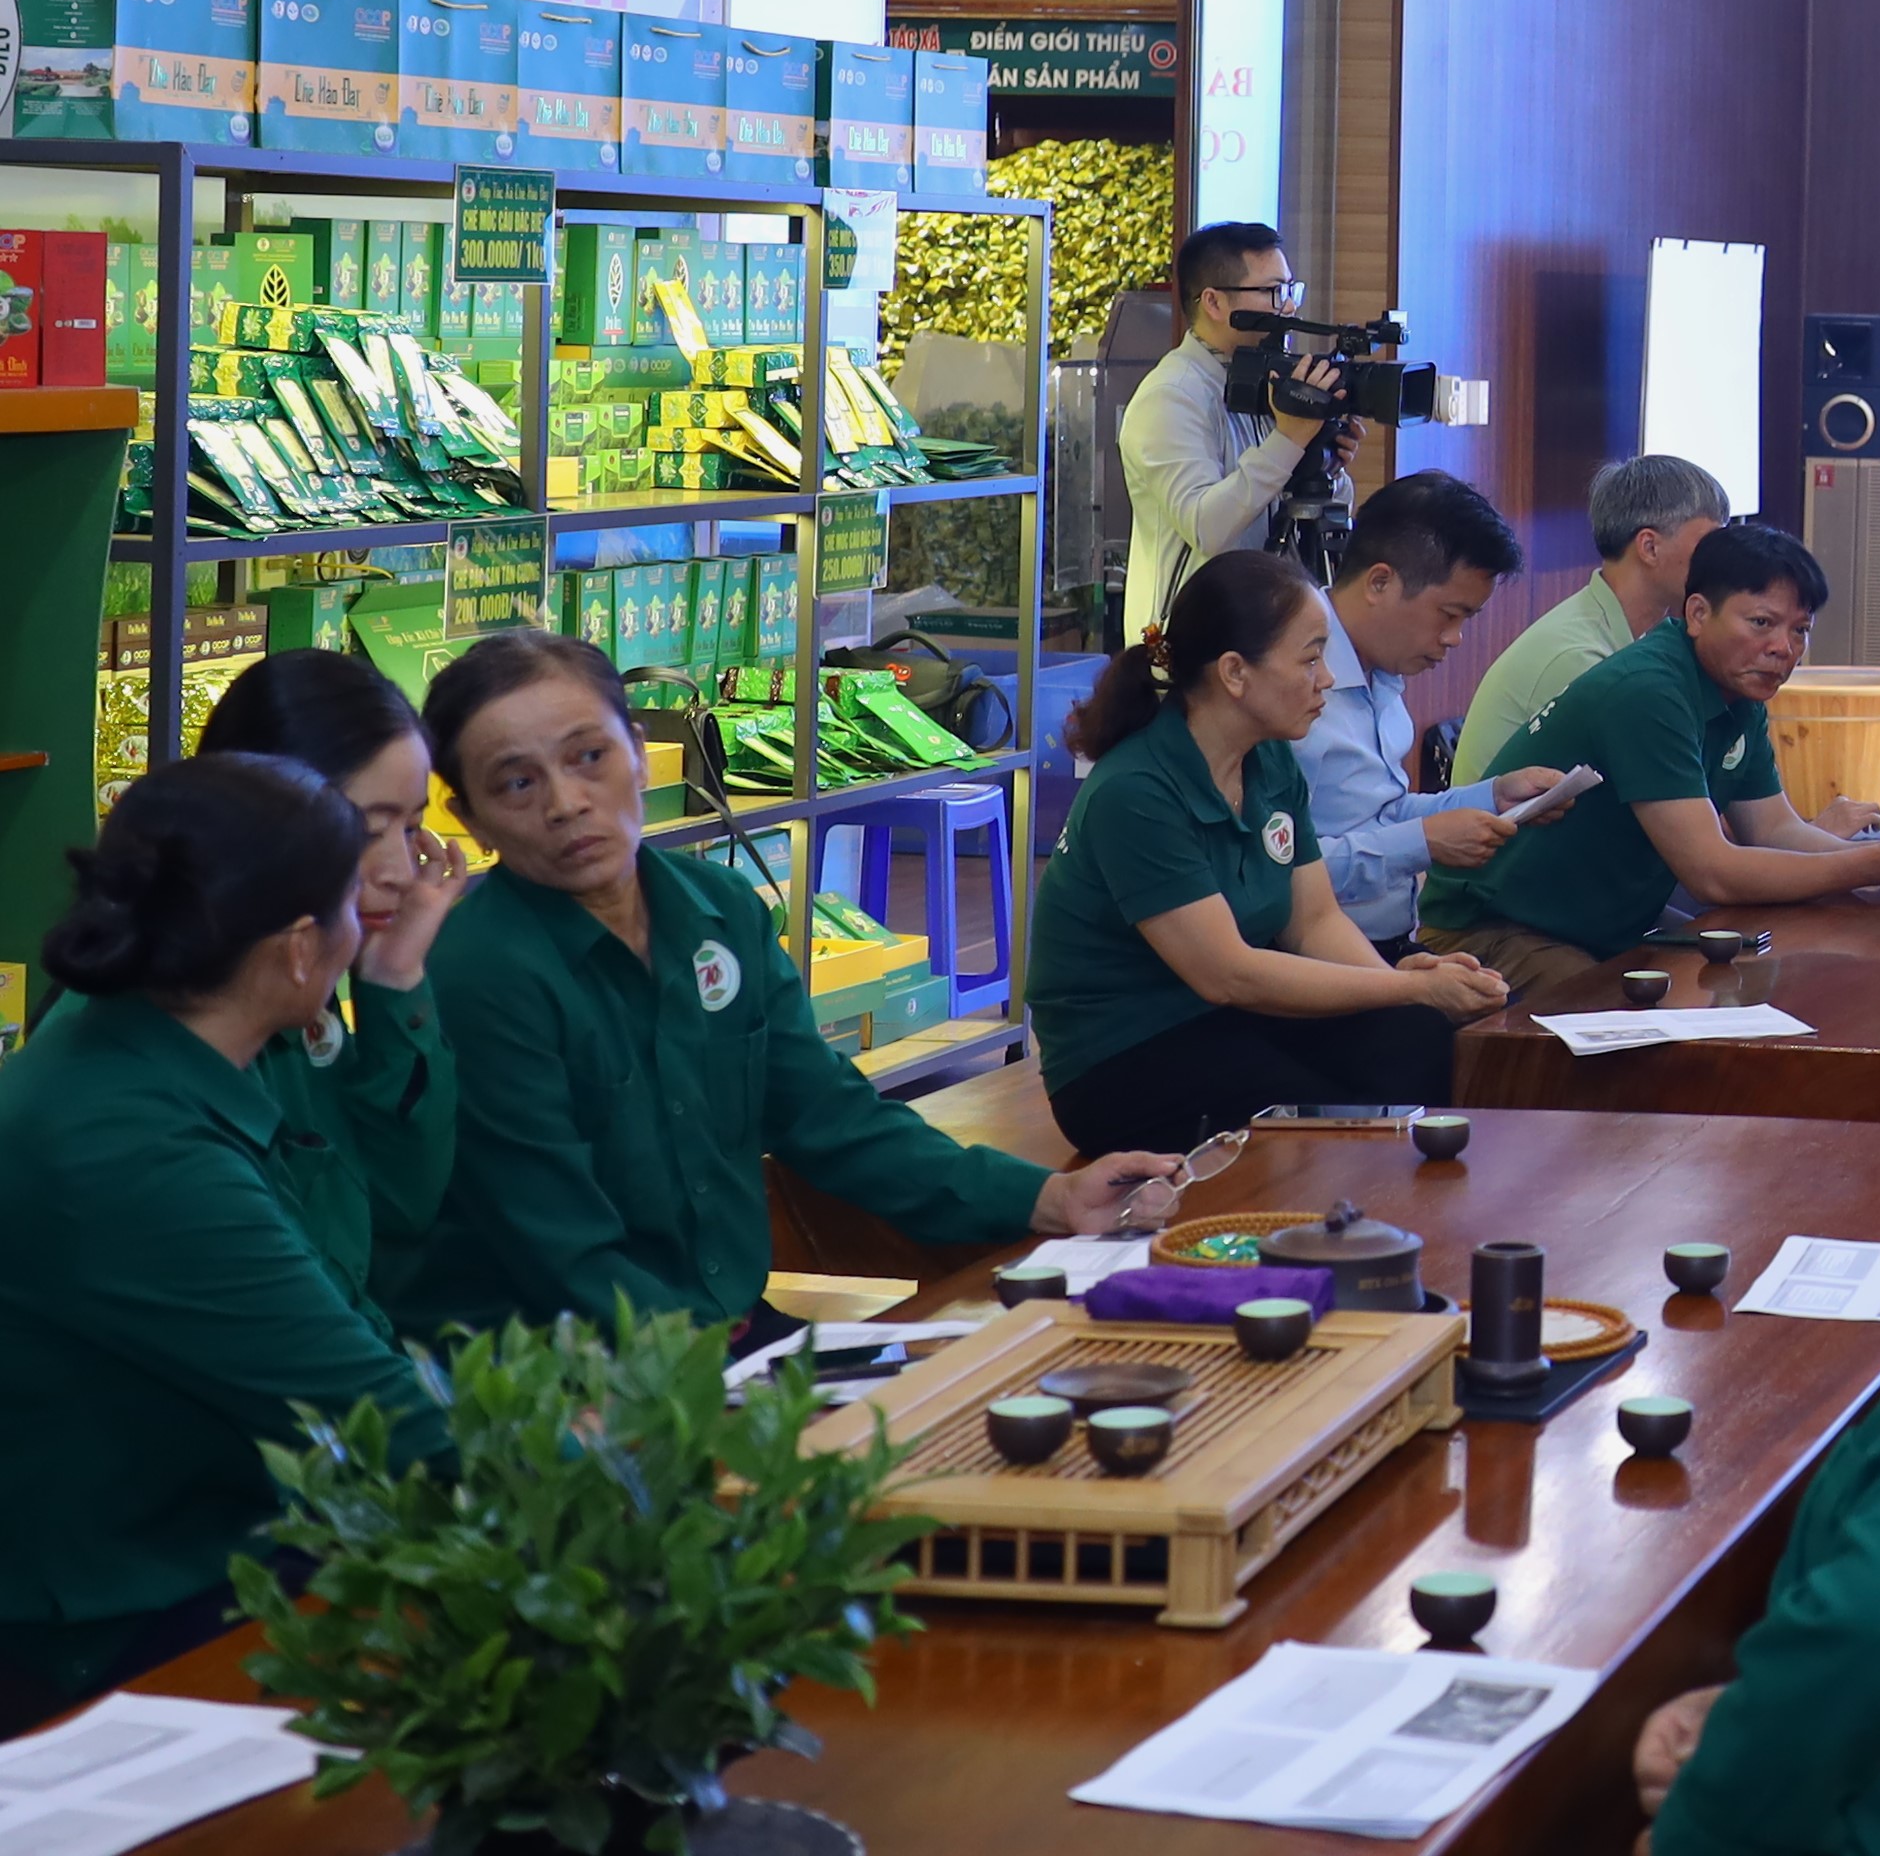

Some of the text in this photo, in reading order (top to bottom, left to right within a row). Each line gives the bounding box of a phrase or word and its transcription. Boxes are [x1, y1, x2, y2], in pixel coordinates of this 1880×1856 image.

[970, 21, 1145, 58] ĐIỂM GIỚI THIỆU
[1024, 63, 1068, 89] SẢN
[1075, 60, 1140, 90] PHẨM
